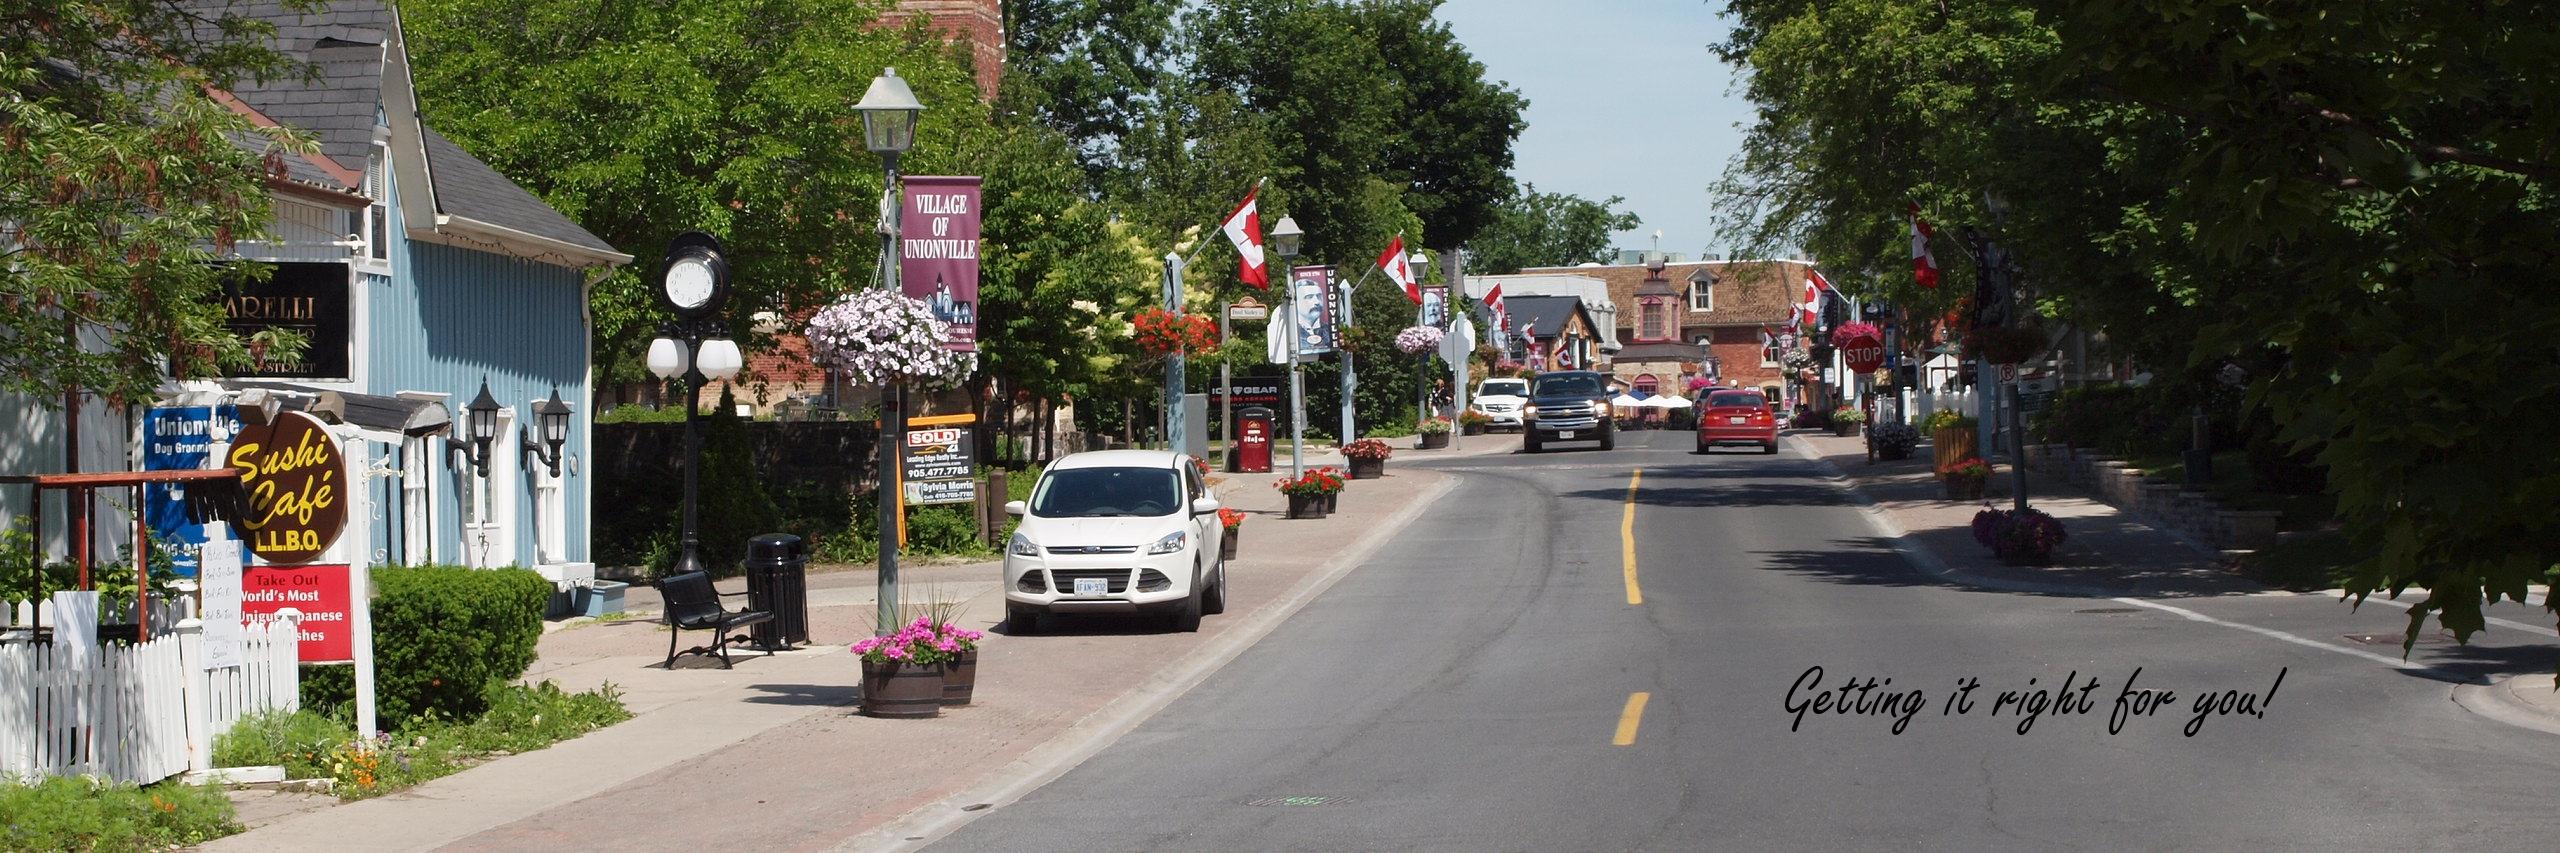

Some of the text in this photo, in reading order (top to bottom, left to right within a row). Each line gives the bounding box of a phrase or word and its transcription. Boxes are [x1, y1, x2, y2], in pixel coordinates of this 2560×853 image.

[916, 194, 967, 214] VILLAGE
[932, 217, 949, 237] OF
[905, 239, 975, 260] UNIONVILLE
[225, 296, 315, 319] ARELLI
[1327, 270, 1338, 348] UNIONVILLE
[1846, 347, 1881, 363] STOP
[1243, 386, 1277, 394] GEAR
[155, 415, 240, 437] Unionvlle
[911, 430, 955, 444] SOLD
[154, 442, 211, 456] Dog Groomi
[232, 428, 329, 483] Sushi
[923, 480, 974, 493] Sylvia Morris
[243, 470, 334, 530] Café
[255, 529, 321, 552] L.L.B.O.
[256, 574, 319, 586] Take Out
[287, 589, 319, 602] Most
[296, 611, 343, 625] panese
[297, 629, 325, 642] shes
